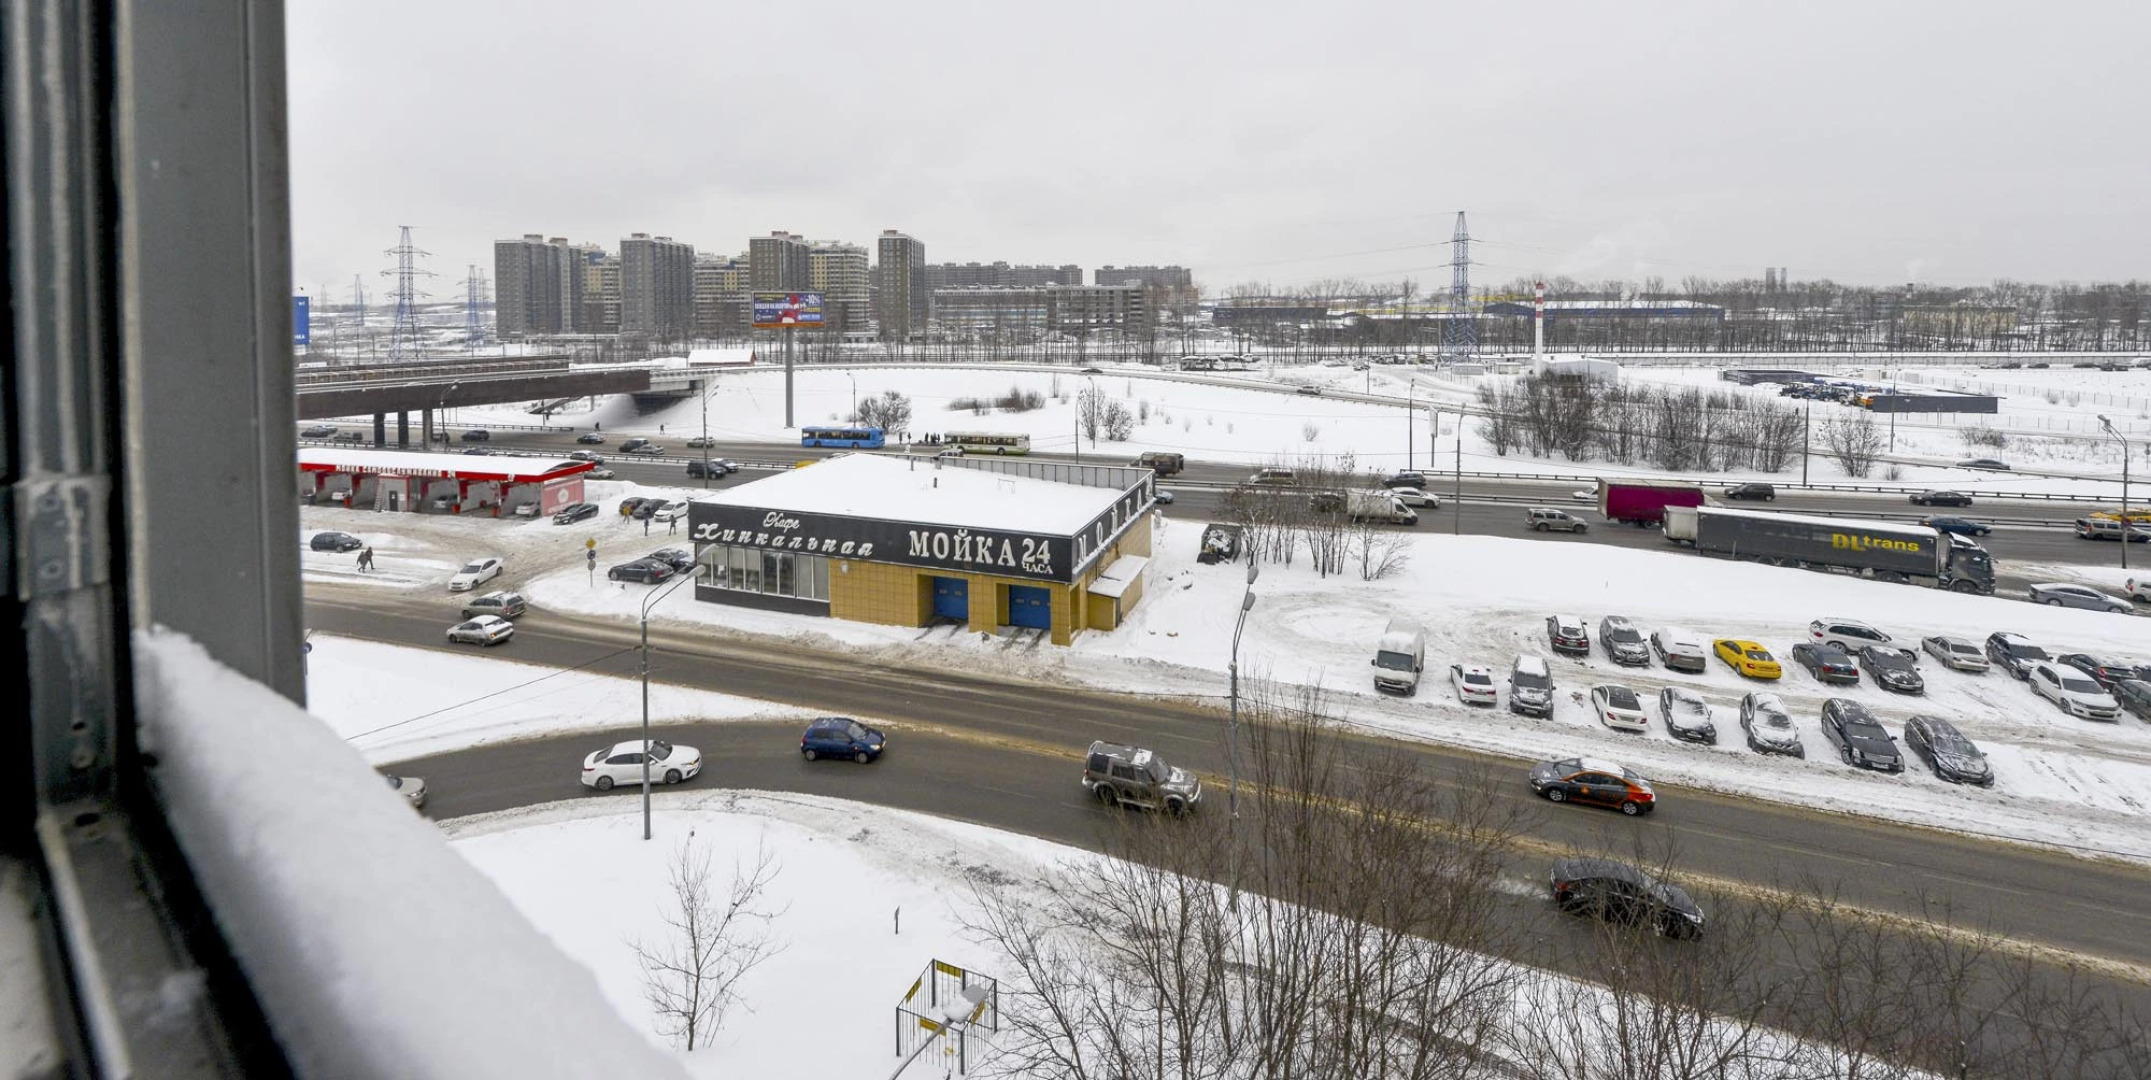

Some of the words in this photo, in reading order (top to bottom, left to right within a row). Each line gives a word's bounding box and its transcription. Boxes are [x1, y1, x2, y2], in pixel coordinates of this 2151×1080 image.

[763, 511, 800, 533] Кафе
[1079, 488, 1142, 563] МОЙКА
[694, 523, 873, 556] Хинкальная
[909, 529, 1016, 567] МОЙКА
[1022, 538, 1050, 564] 24
[1021, 560, 1053, 574] ЧАСА
